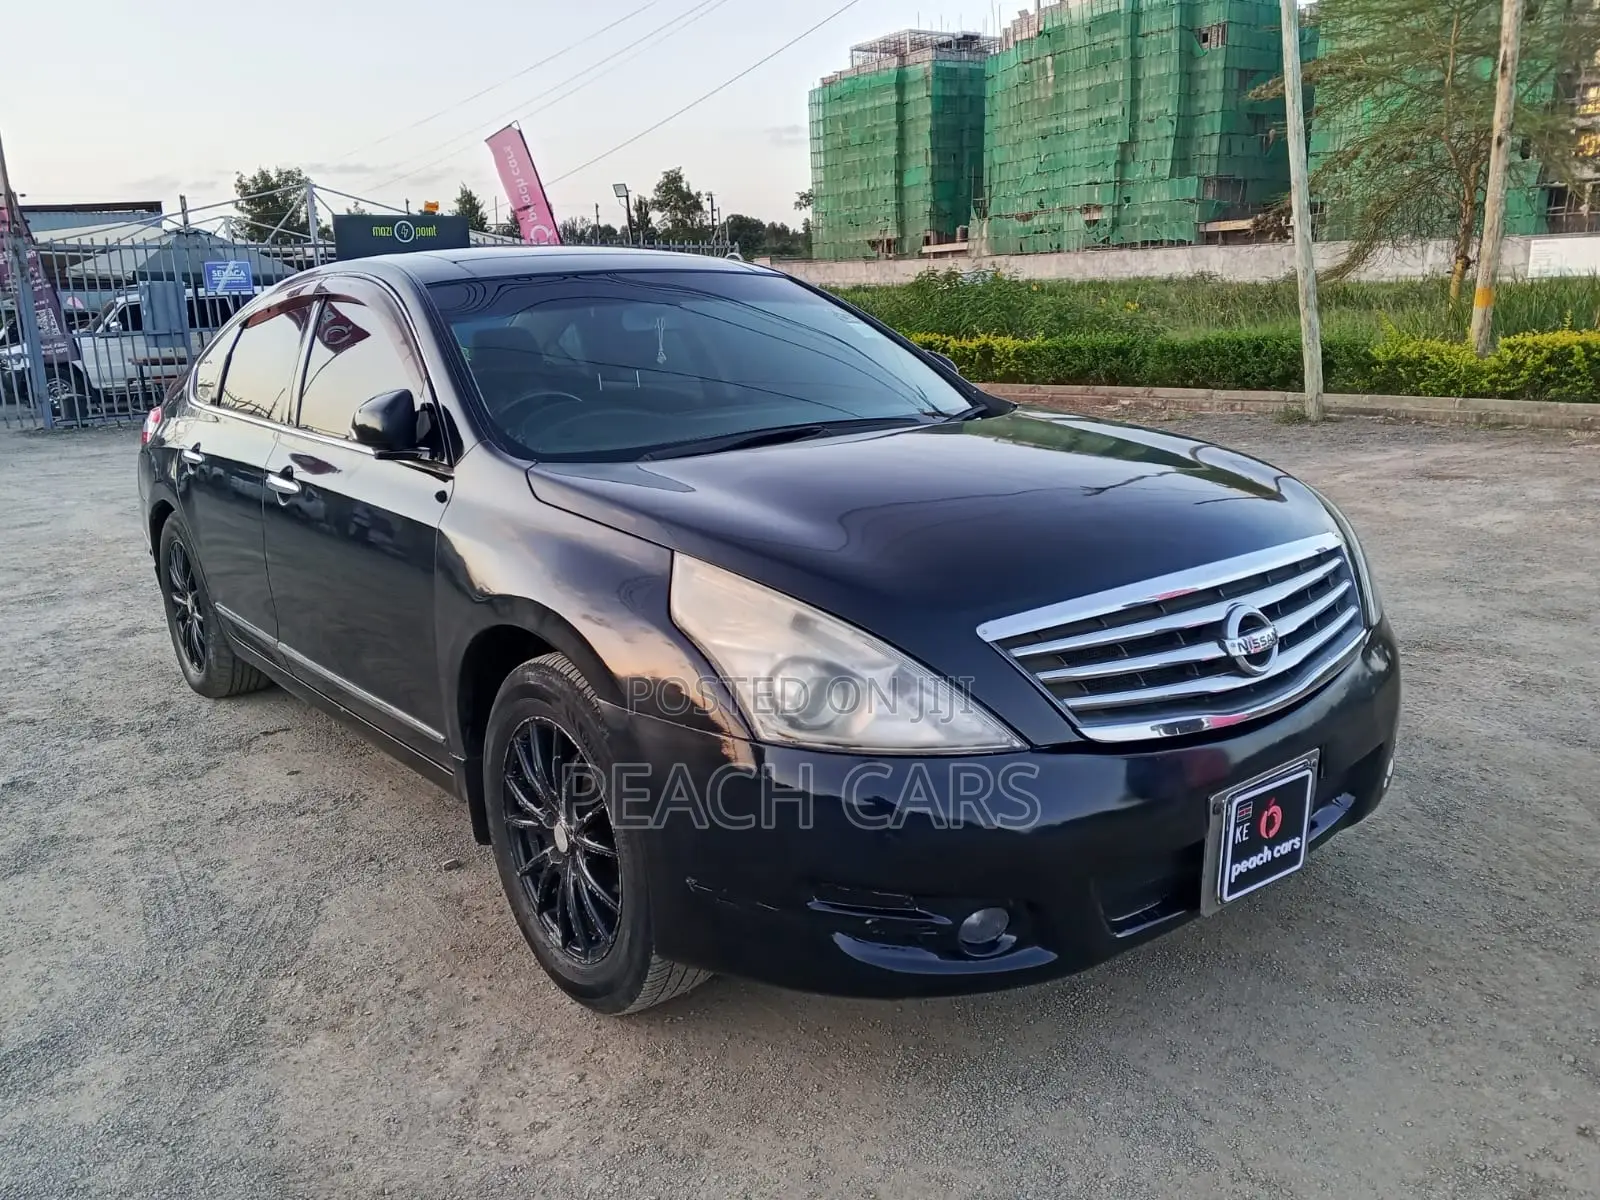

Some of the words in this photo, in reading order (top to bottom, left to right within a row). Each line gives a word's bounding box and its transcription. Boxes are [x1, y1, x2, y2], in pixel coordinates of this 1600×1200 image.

[415, 224, 437, 240] point
[1237, 628, 1278, 652] NISSAN
[1234, 822, 1251, 845] KE
[1230, 845, 1272, 883] peach
[1273, 836, 1302, 858] cars
